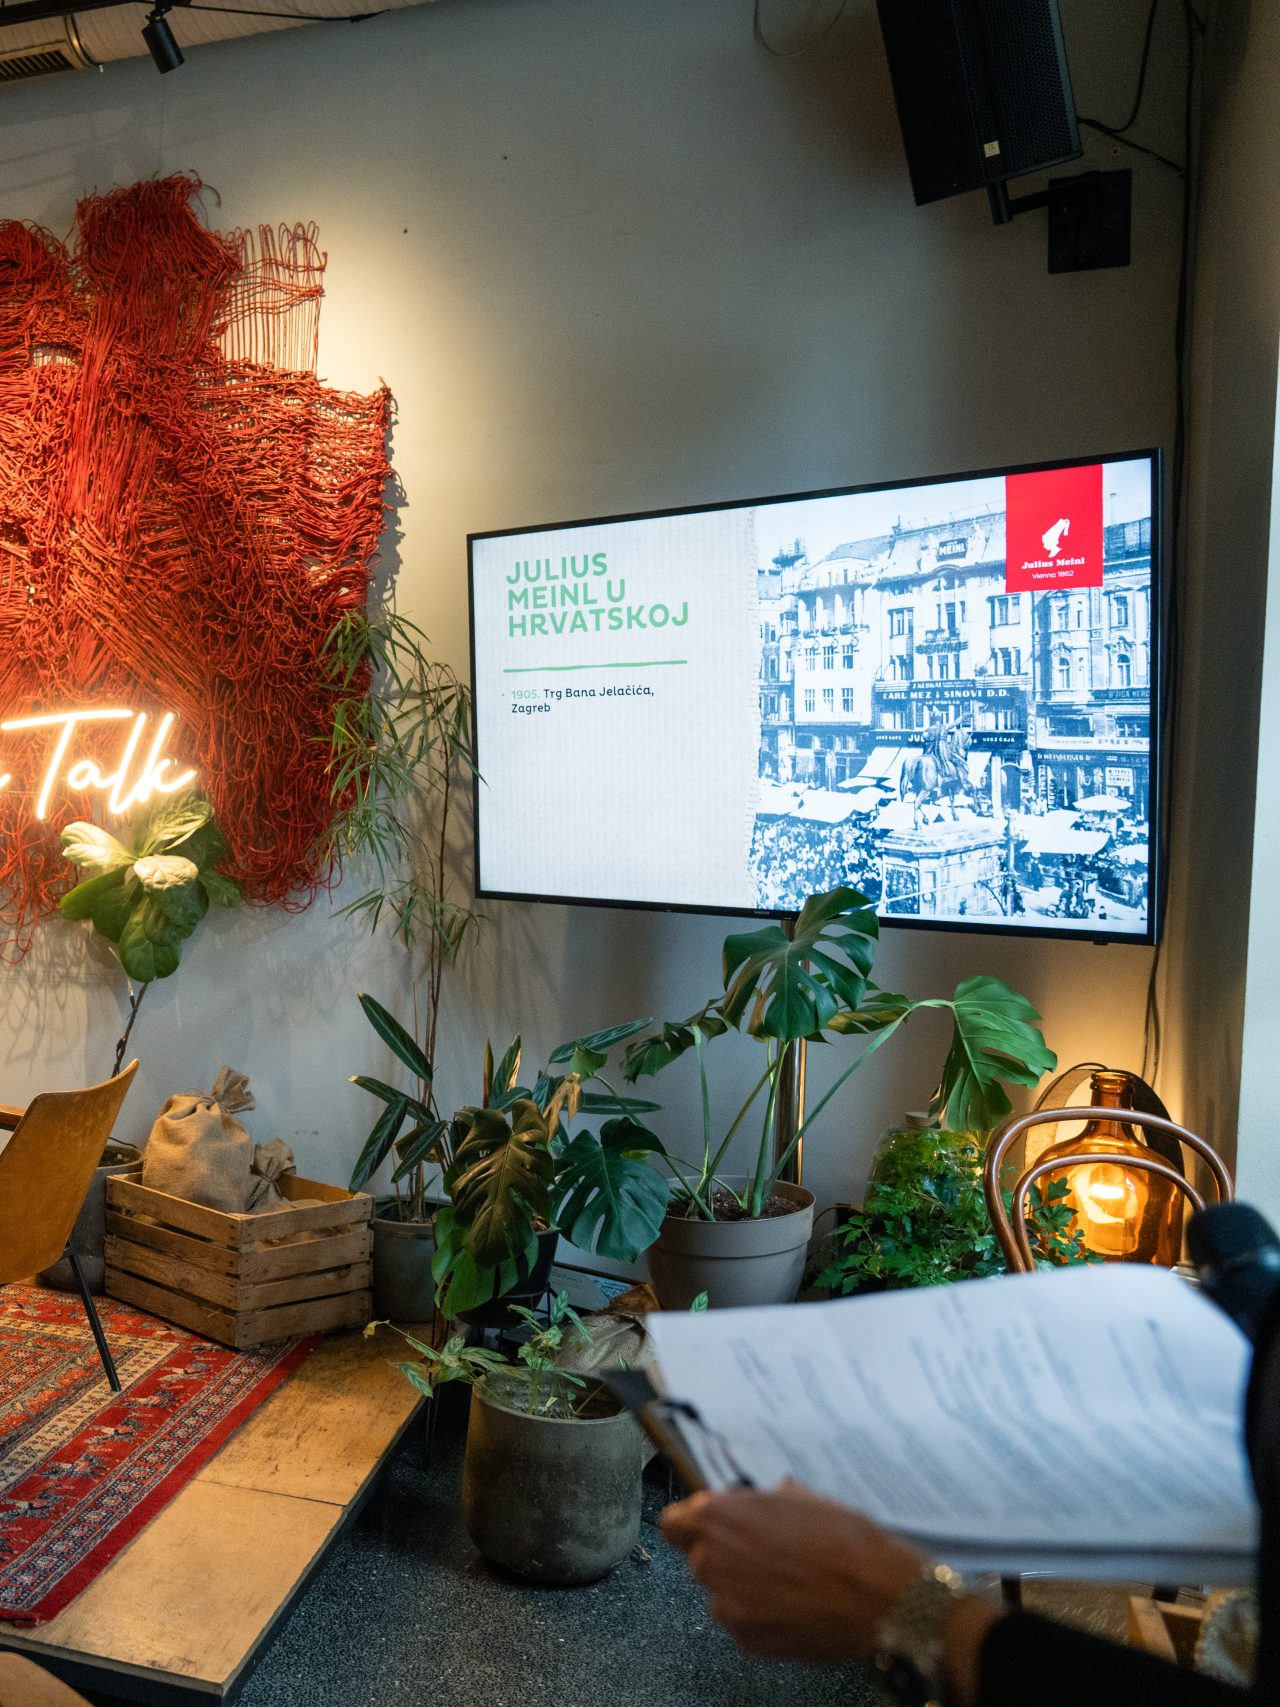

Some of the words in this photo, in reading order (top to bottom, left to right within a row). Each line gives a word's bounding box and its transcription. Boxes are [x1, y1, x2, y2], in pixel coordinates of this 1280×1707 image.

[506, 552, 608, 585] JULIUS
[1021, 560, 1054, 570] Julius
[1056, 557, 1085, 567] Meinl
[508, 582, 598, 611] MEINL
[606, 579, 626, 603] U
[509, 602, 689, 638] HRVATSKOJ
[511, 689, 541, 700] 1905.
[544, 688, 562, 701] Trg
[565, 688, 596, 698] Bana
[599, 684, 655, 697] Jelačića,
[883, 692, 907, 700] CARL
[910, 691, 932, 699] MEZ
[944, 689, 982, 698] SINOVI
[987, 689, 1010, 697] D.D.
[511, 703, 551, 715] Zagreb
[0, 708, 197, 820] Talk
